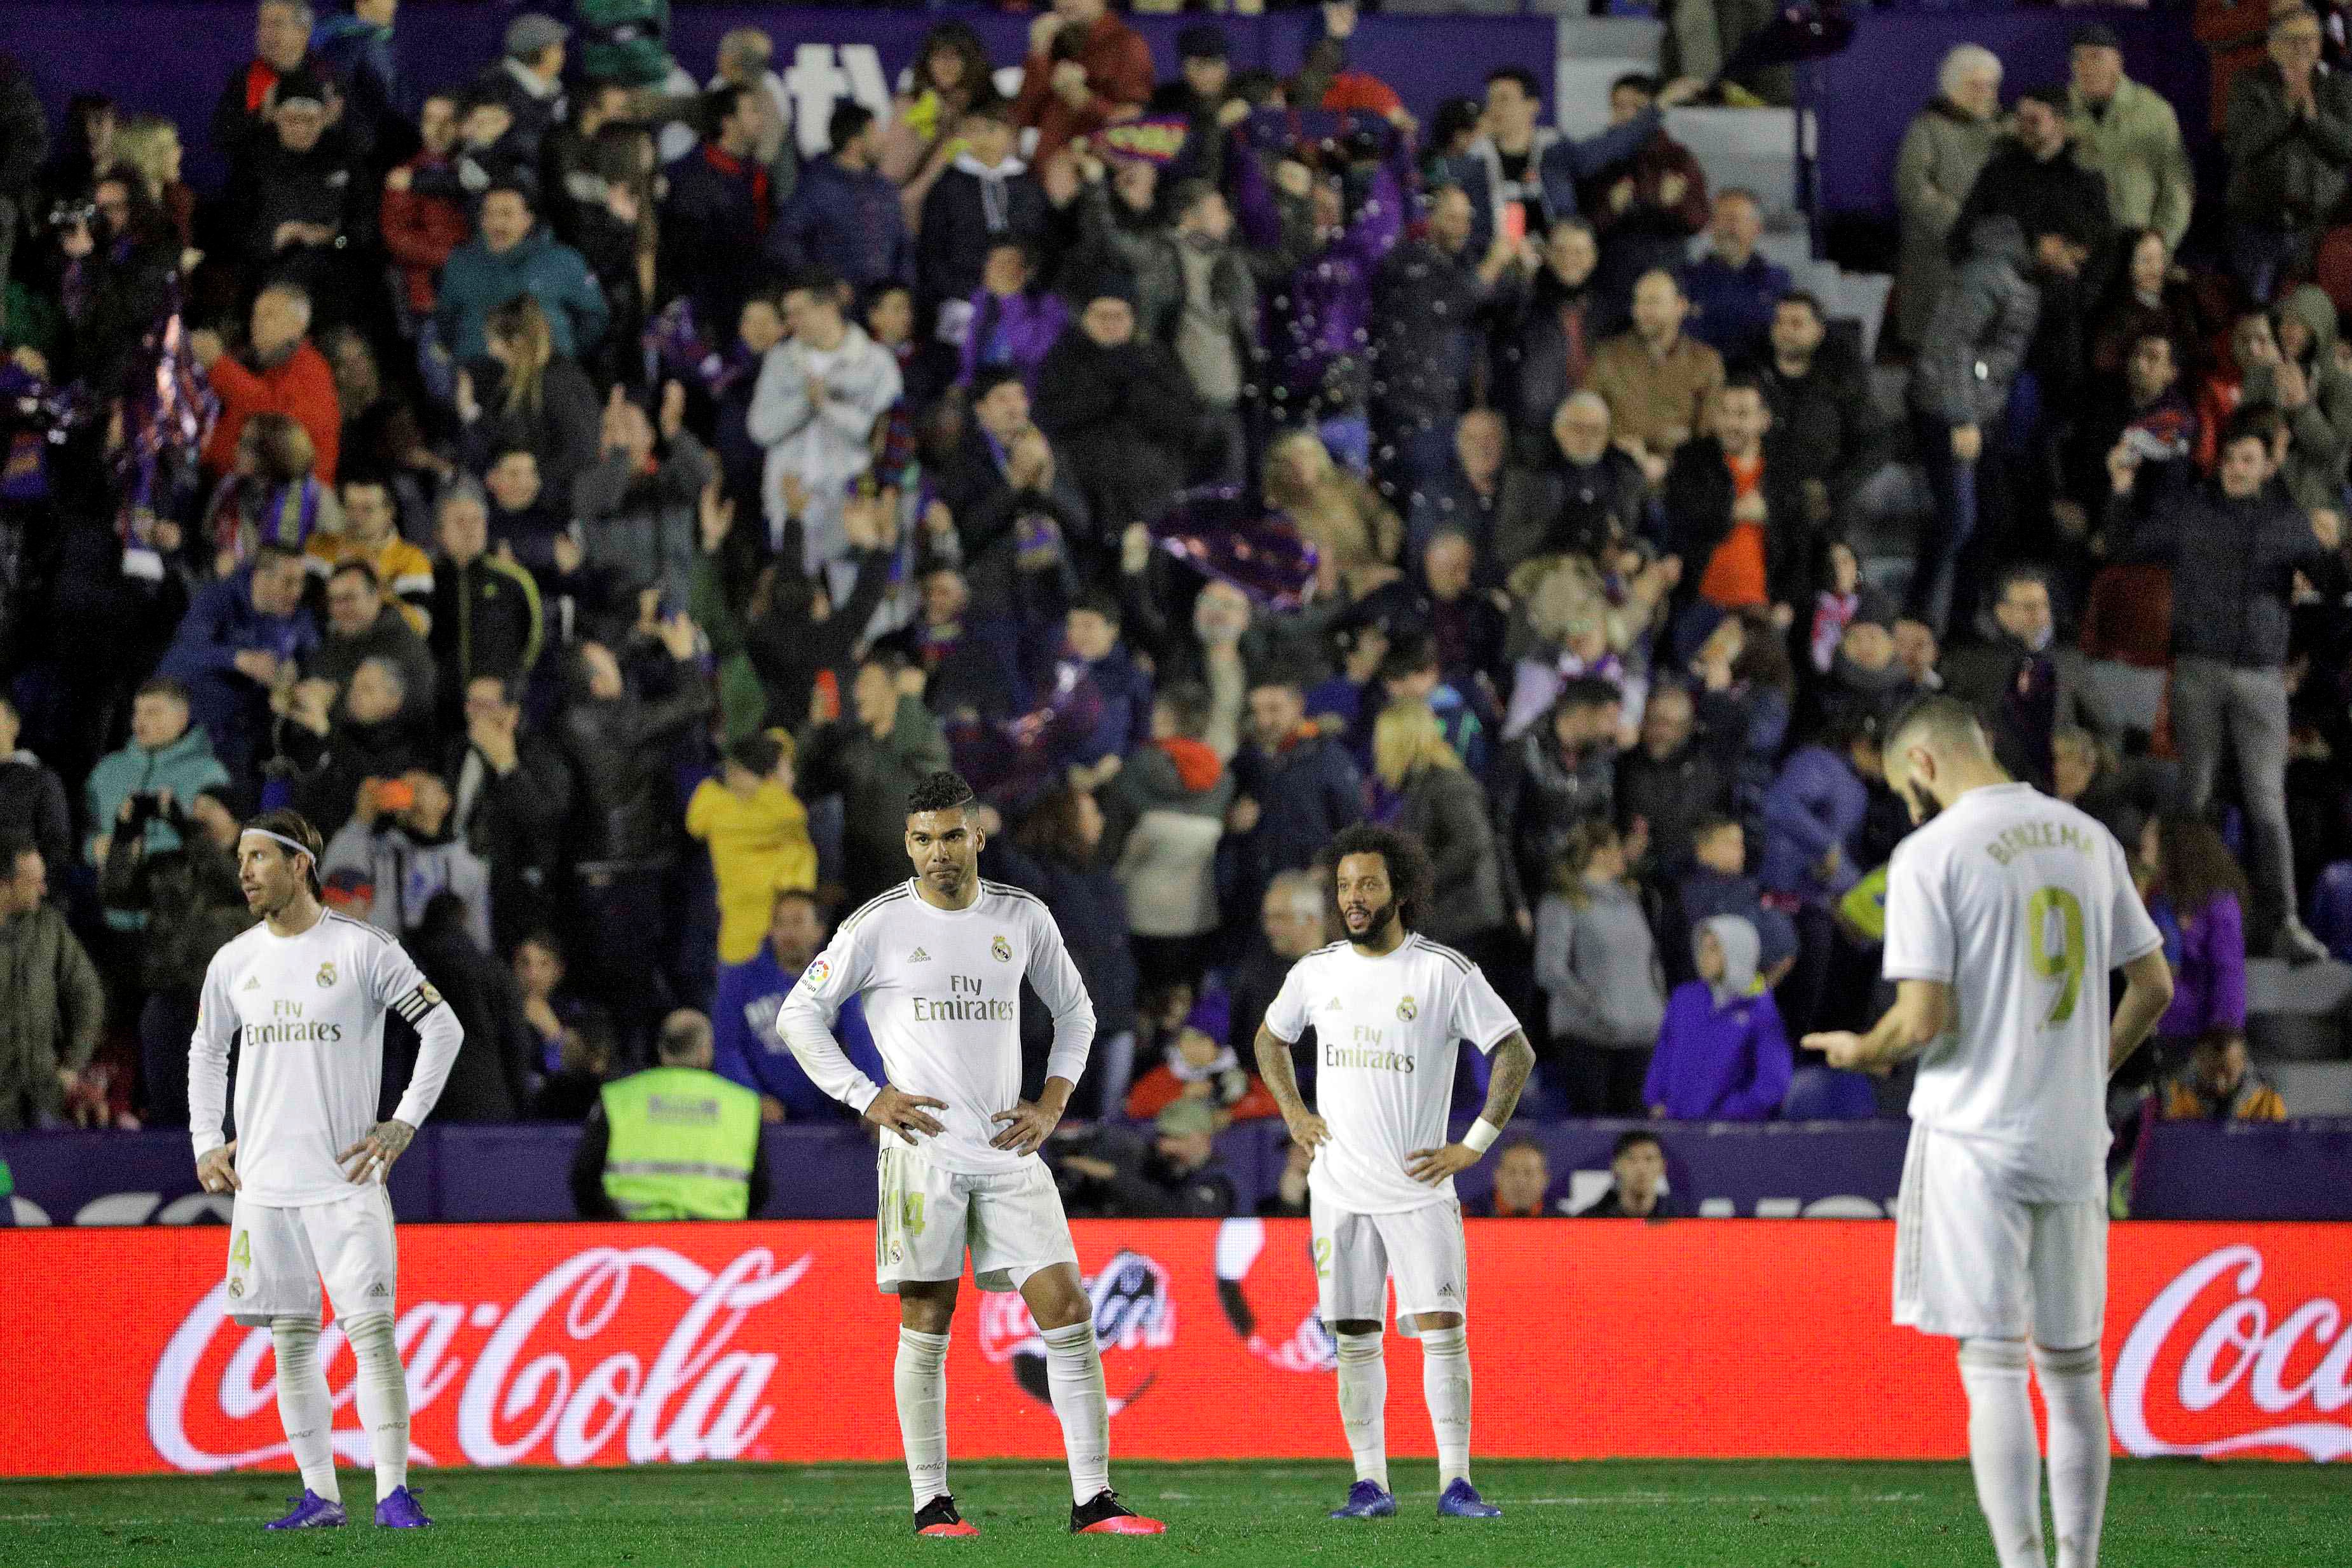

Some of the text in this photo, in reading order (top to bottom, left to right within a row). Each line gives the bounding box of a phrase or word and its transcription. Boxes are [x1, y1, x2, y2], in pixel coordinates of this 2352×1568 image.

[1986, 819, 2096, 865] BENZEMA
[2027, 885, 2086, 1025] 9
[950, 975, 982, 996] Fly
[273, 999, 302, 1018] Fly
[913, 994, 1013, 1021] Emirates
[246, 1018, 341, 1047] Emirates
[1353, 1025, 1382, 1046] Fly
[1326, 1043, 1415, 1074] Emirates
[232, 1230, 251, 1270] 4
